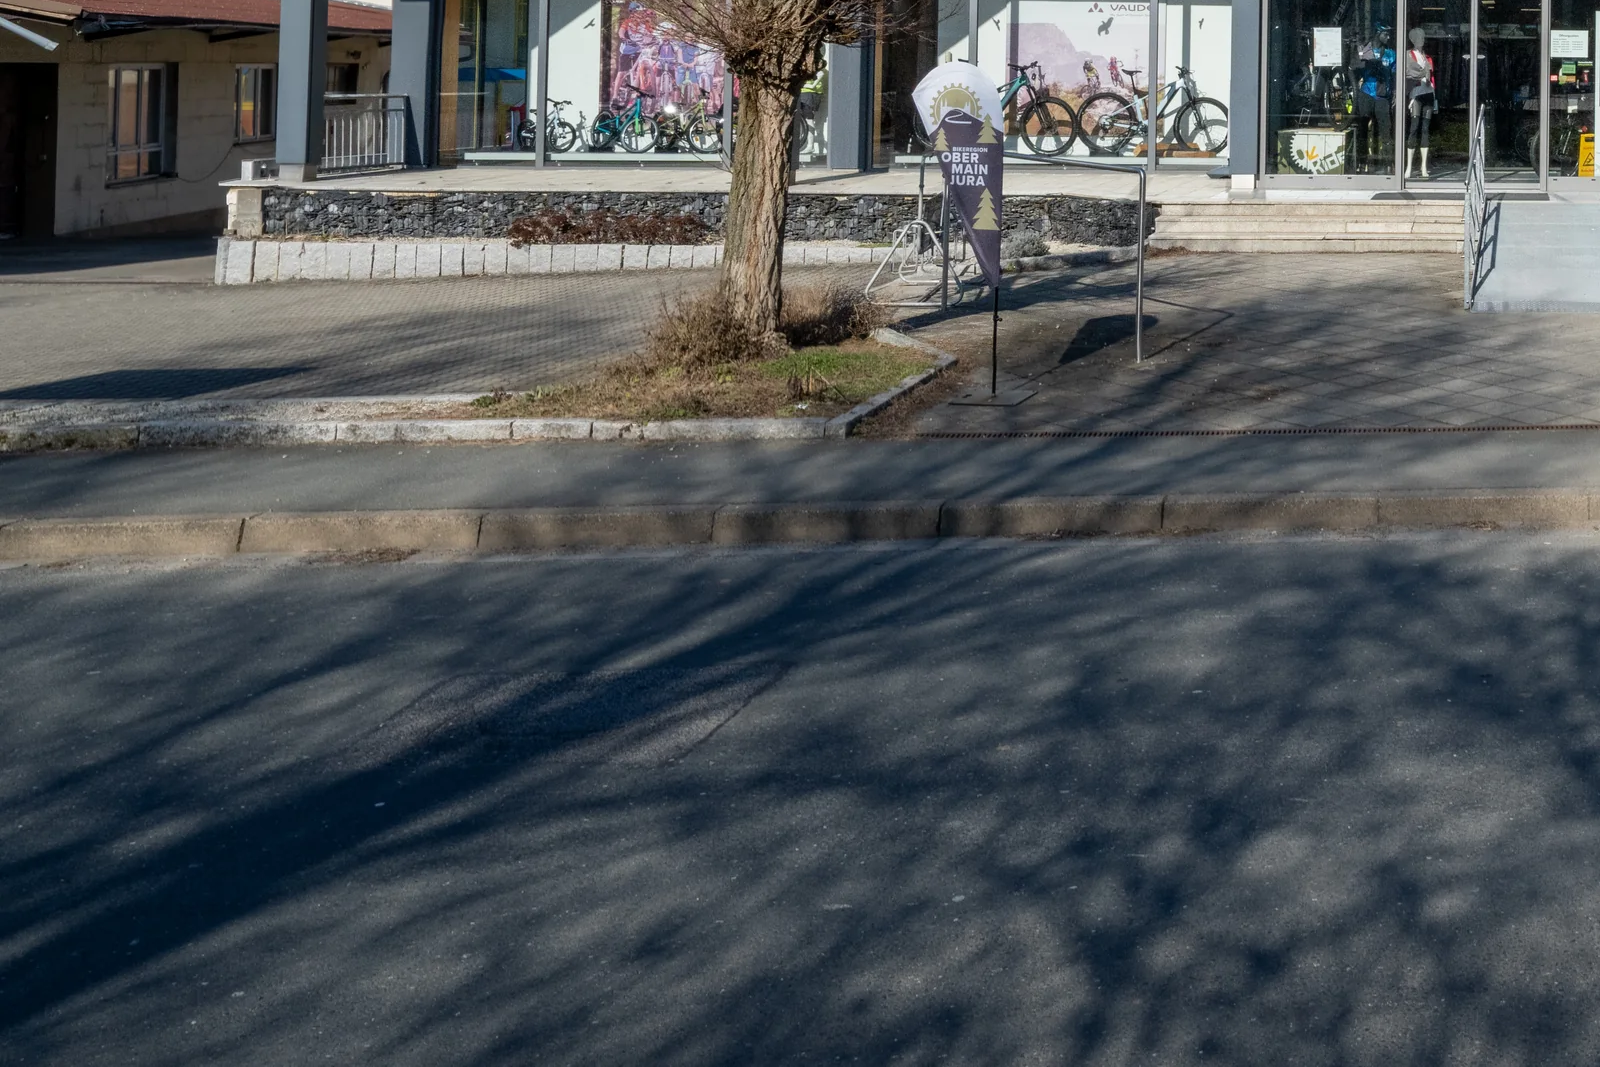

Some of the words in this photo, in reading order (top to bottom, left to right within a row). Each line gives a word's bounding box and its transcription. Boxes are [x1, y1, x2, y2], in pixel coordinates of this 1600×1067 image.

[941, 151, 979, 163] OBER
[951, 163, 989, 175] MAIN
[950, 175, 986, 187] JURA
